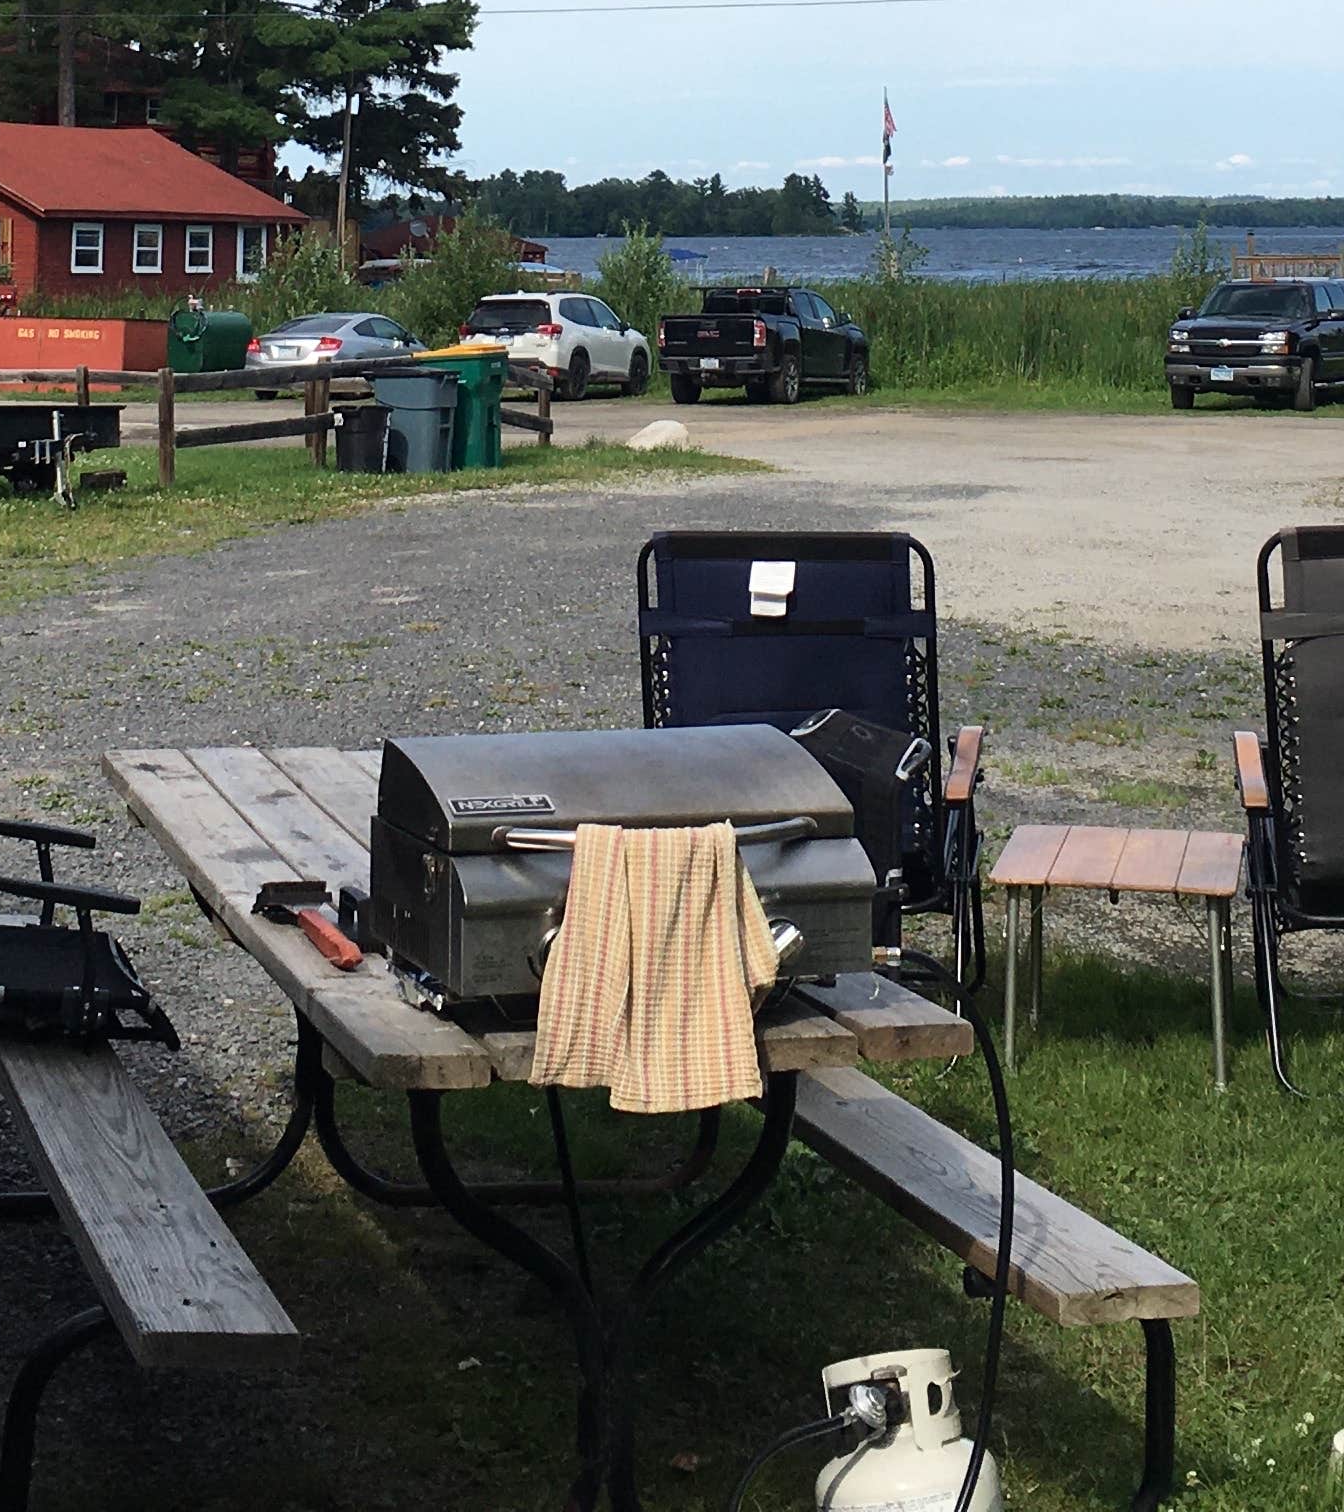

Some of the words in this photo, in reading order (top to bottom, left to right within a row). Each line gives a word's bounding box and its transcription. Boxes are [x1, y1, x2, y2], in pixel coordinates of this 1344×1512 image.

[17, 328, 35, 338] GAS
[48, 328, 60, 338] NO
[63, 329, 100, 340] SMOKING
